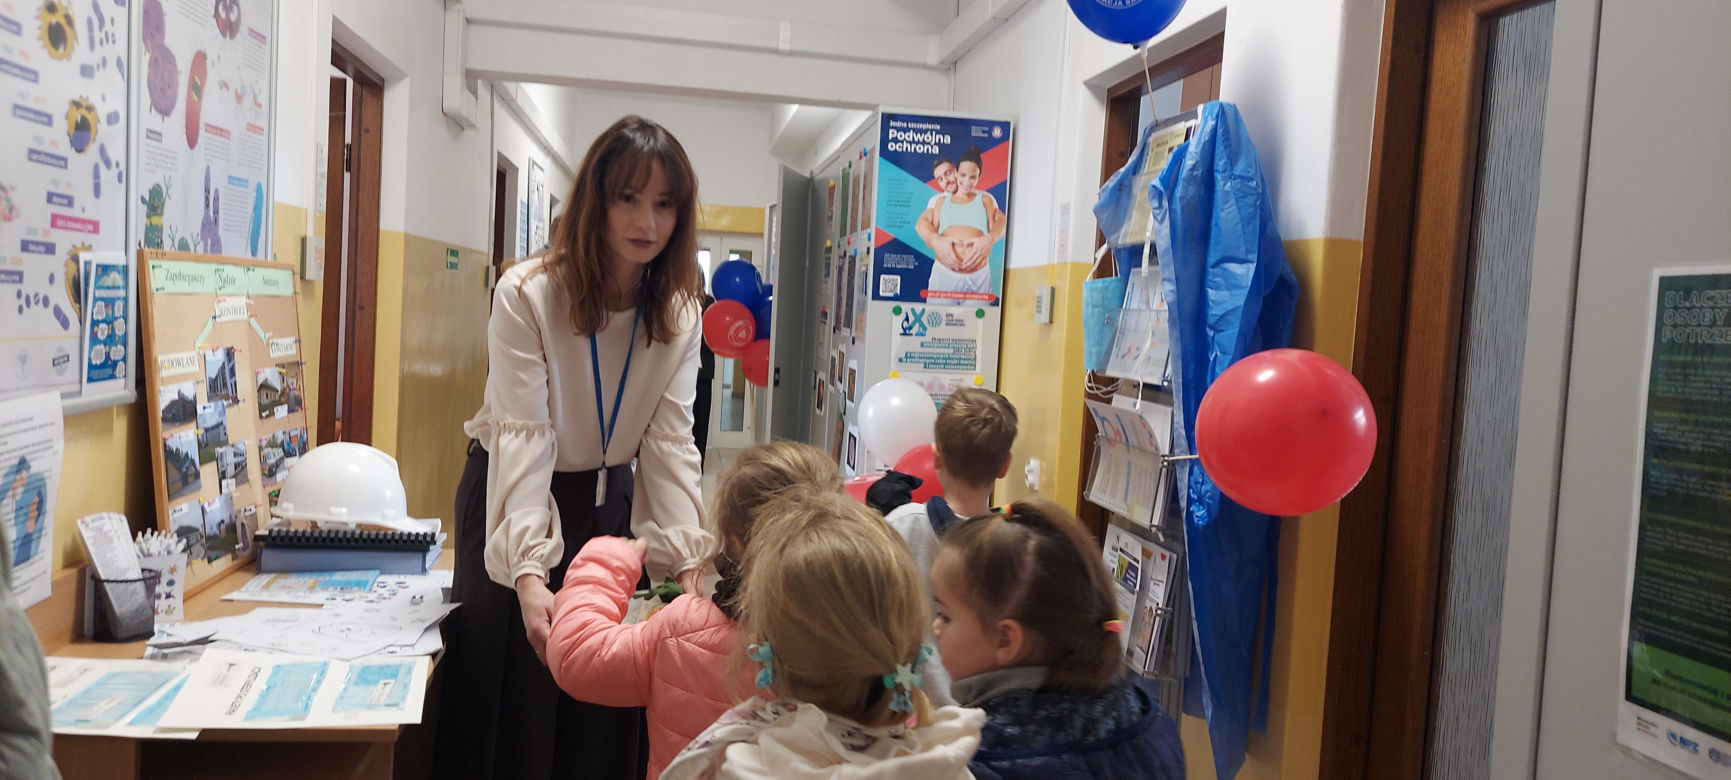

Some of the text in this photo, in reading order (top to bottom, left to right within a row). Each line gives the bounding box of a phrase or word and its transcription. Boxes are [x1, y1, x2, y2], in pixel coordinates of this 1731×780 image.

[889, 120, 940, 130] Jedno szczepienie
[889, 128, 951, 145] Podwójna
[888, 141, 939, 155] ochrona
[1664, 309, 1728, 325] OSOBY
